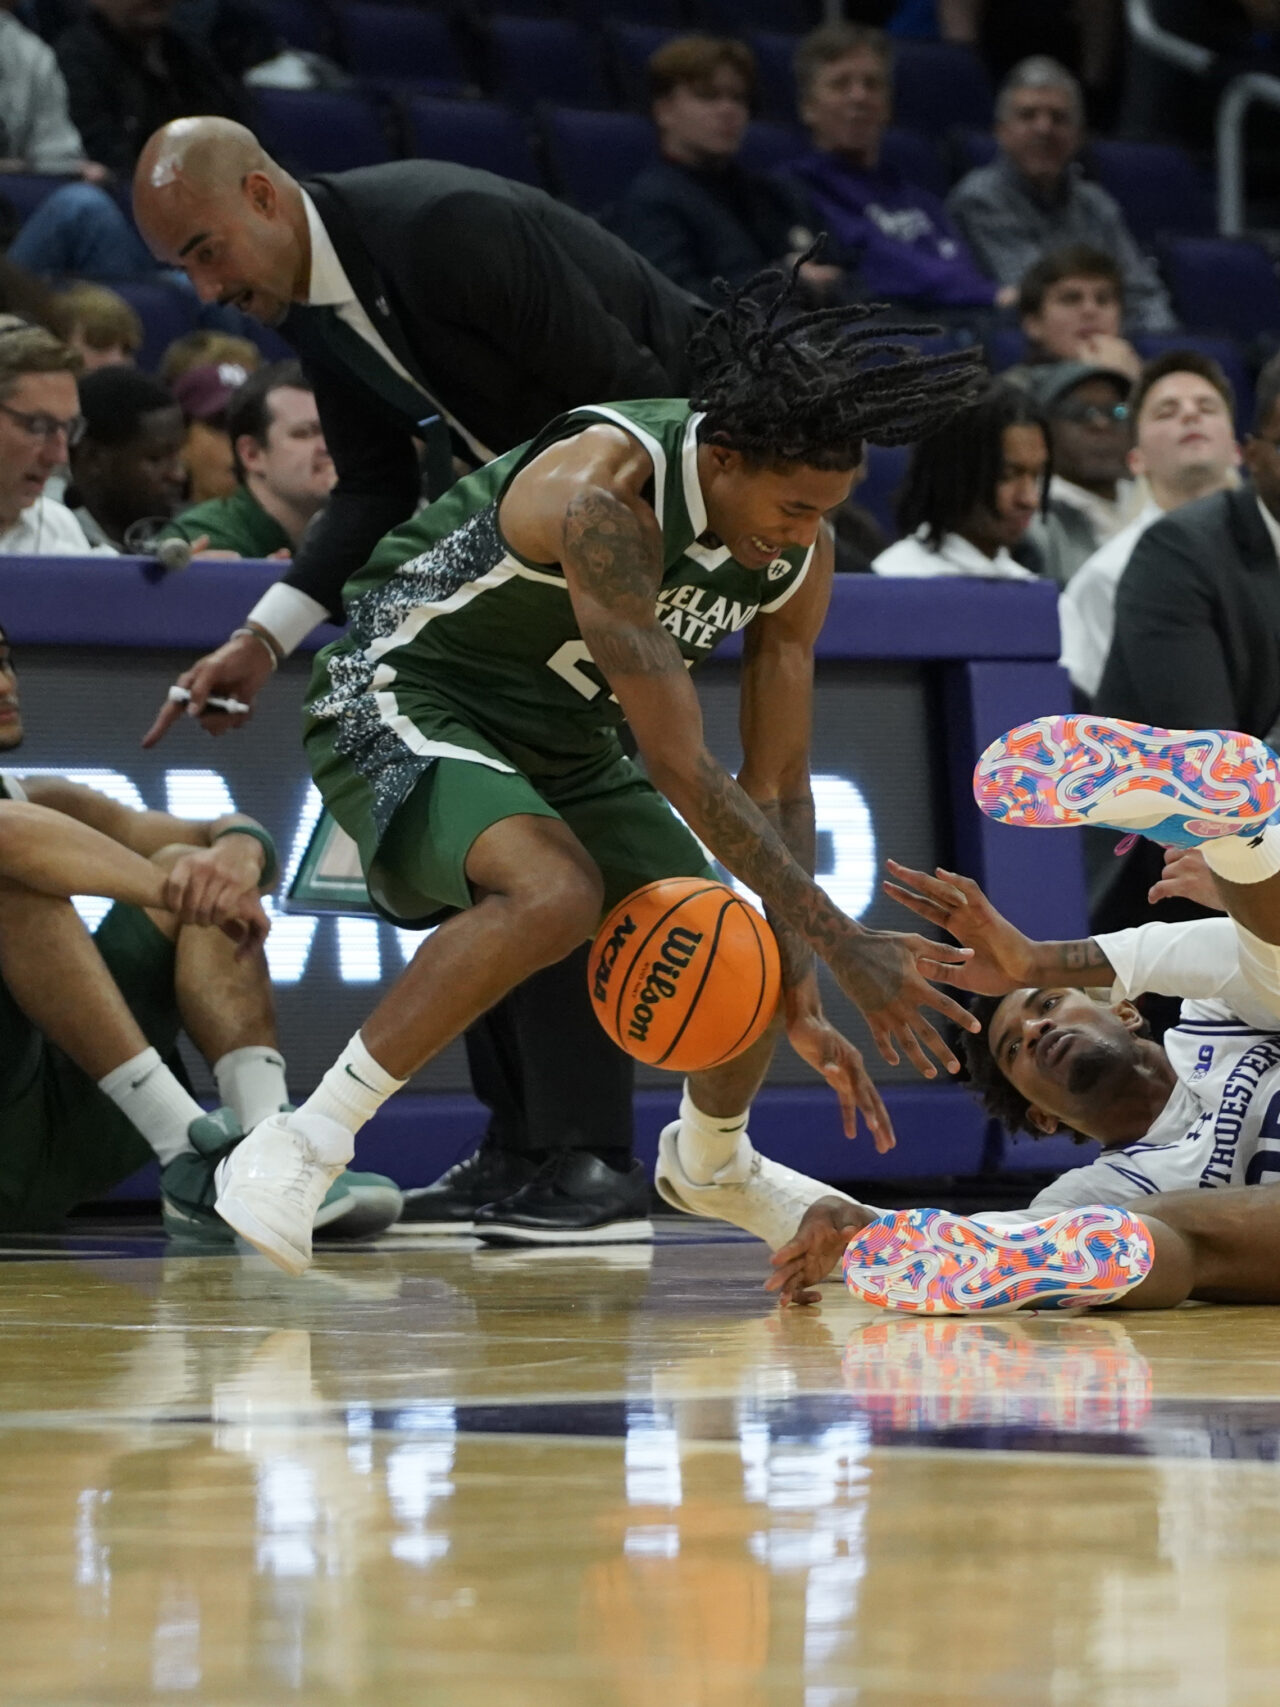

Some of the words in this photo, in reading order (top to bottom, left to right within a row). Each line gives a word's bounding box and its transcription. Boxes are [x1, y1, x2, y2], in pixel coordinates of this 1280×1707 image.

[654, 602, 712, 649] TATE
[593, 913, 637, 1003] NCAA
[627, 926, 704, 1042] Wilson
